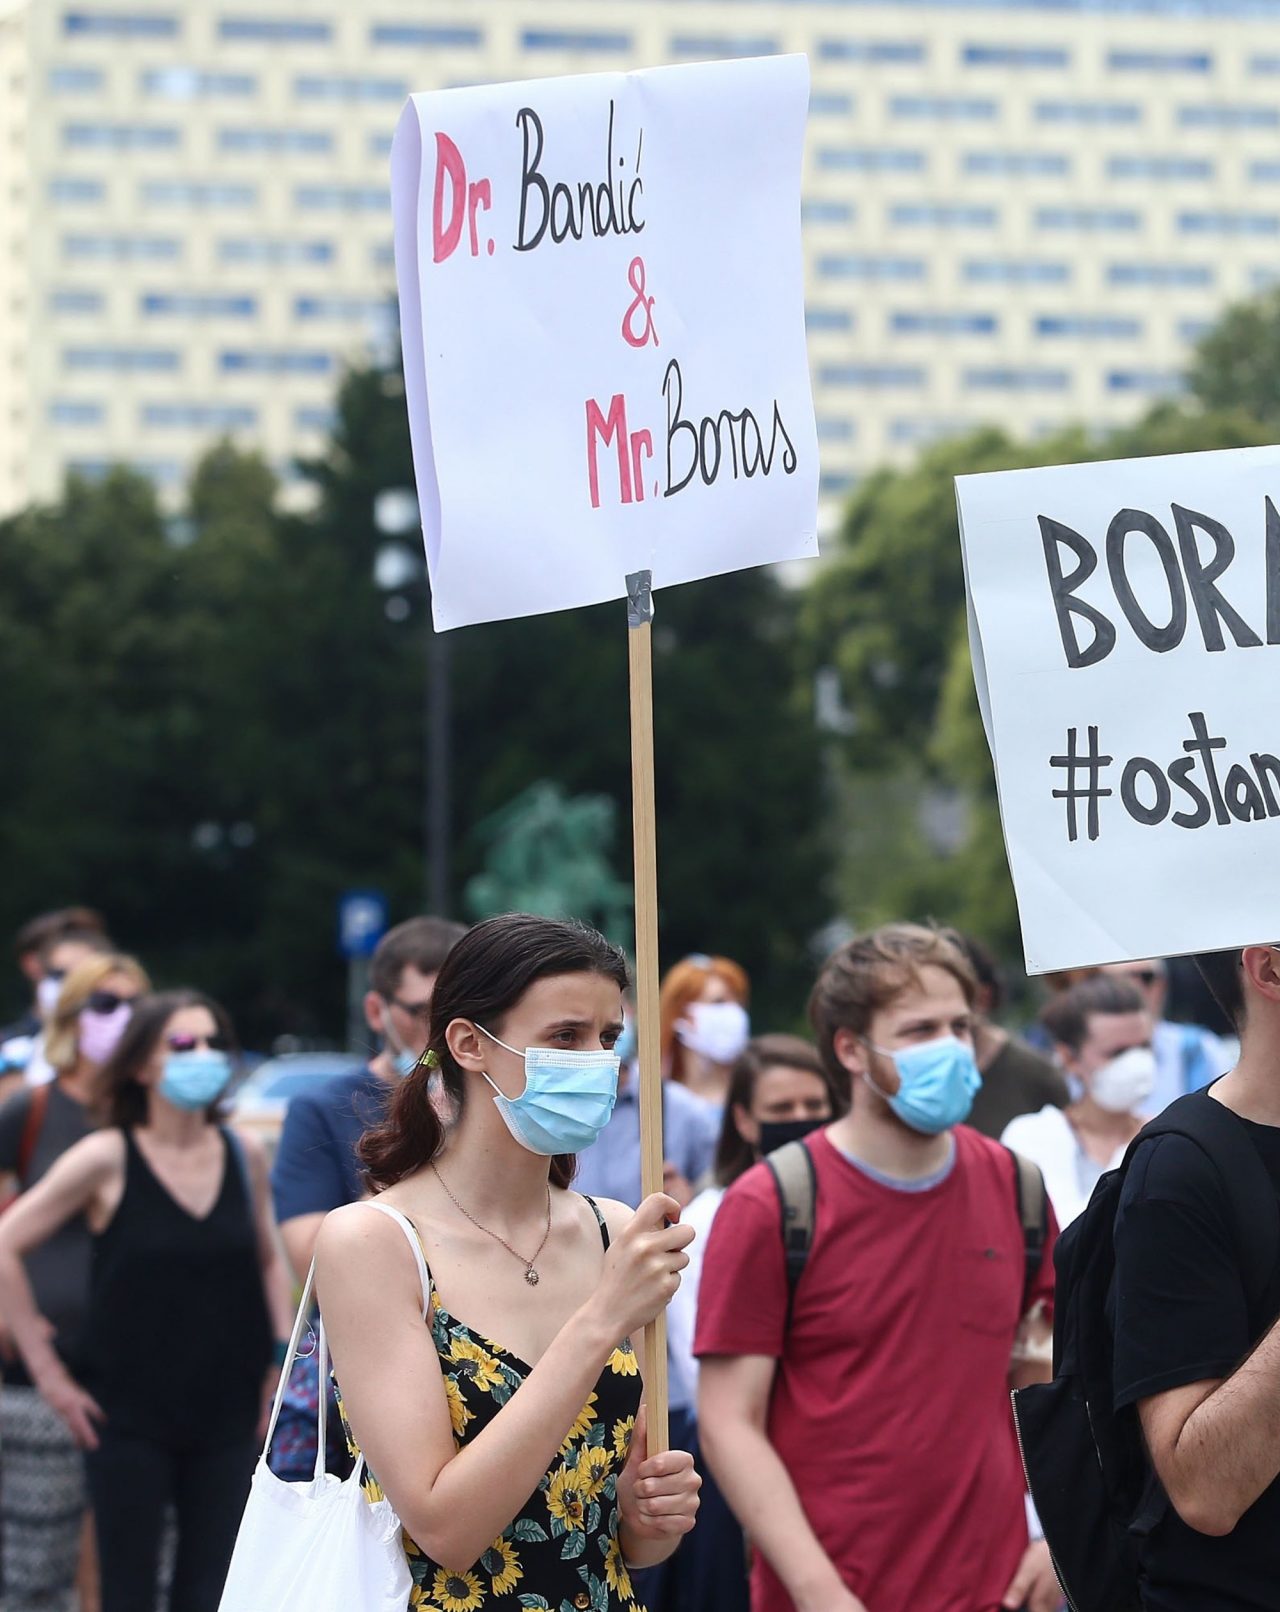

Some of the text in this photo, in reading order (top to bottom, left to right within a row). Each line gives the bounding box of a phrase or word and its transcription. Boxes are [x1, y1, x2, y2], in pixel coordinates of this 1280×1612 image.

[433, 99, 646, 263] Dr. Bandić
[622, 256, 659, 347] &
[586, 358, 797, 508] Mr. Boras
